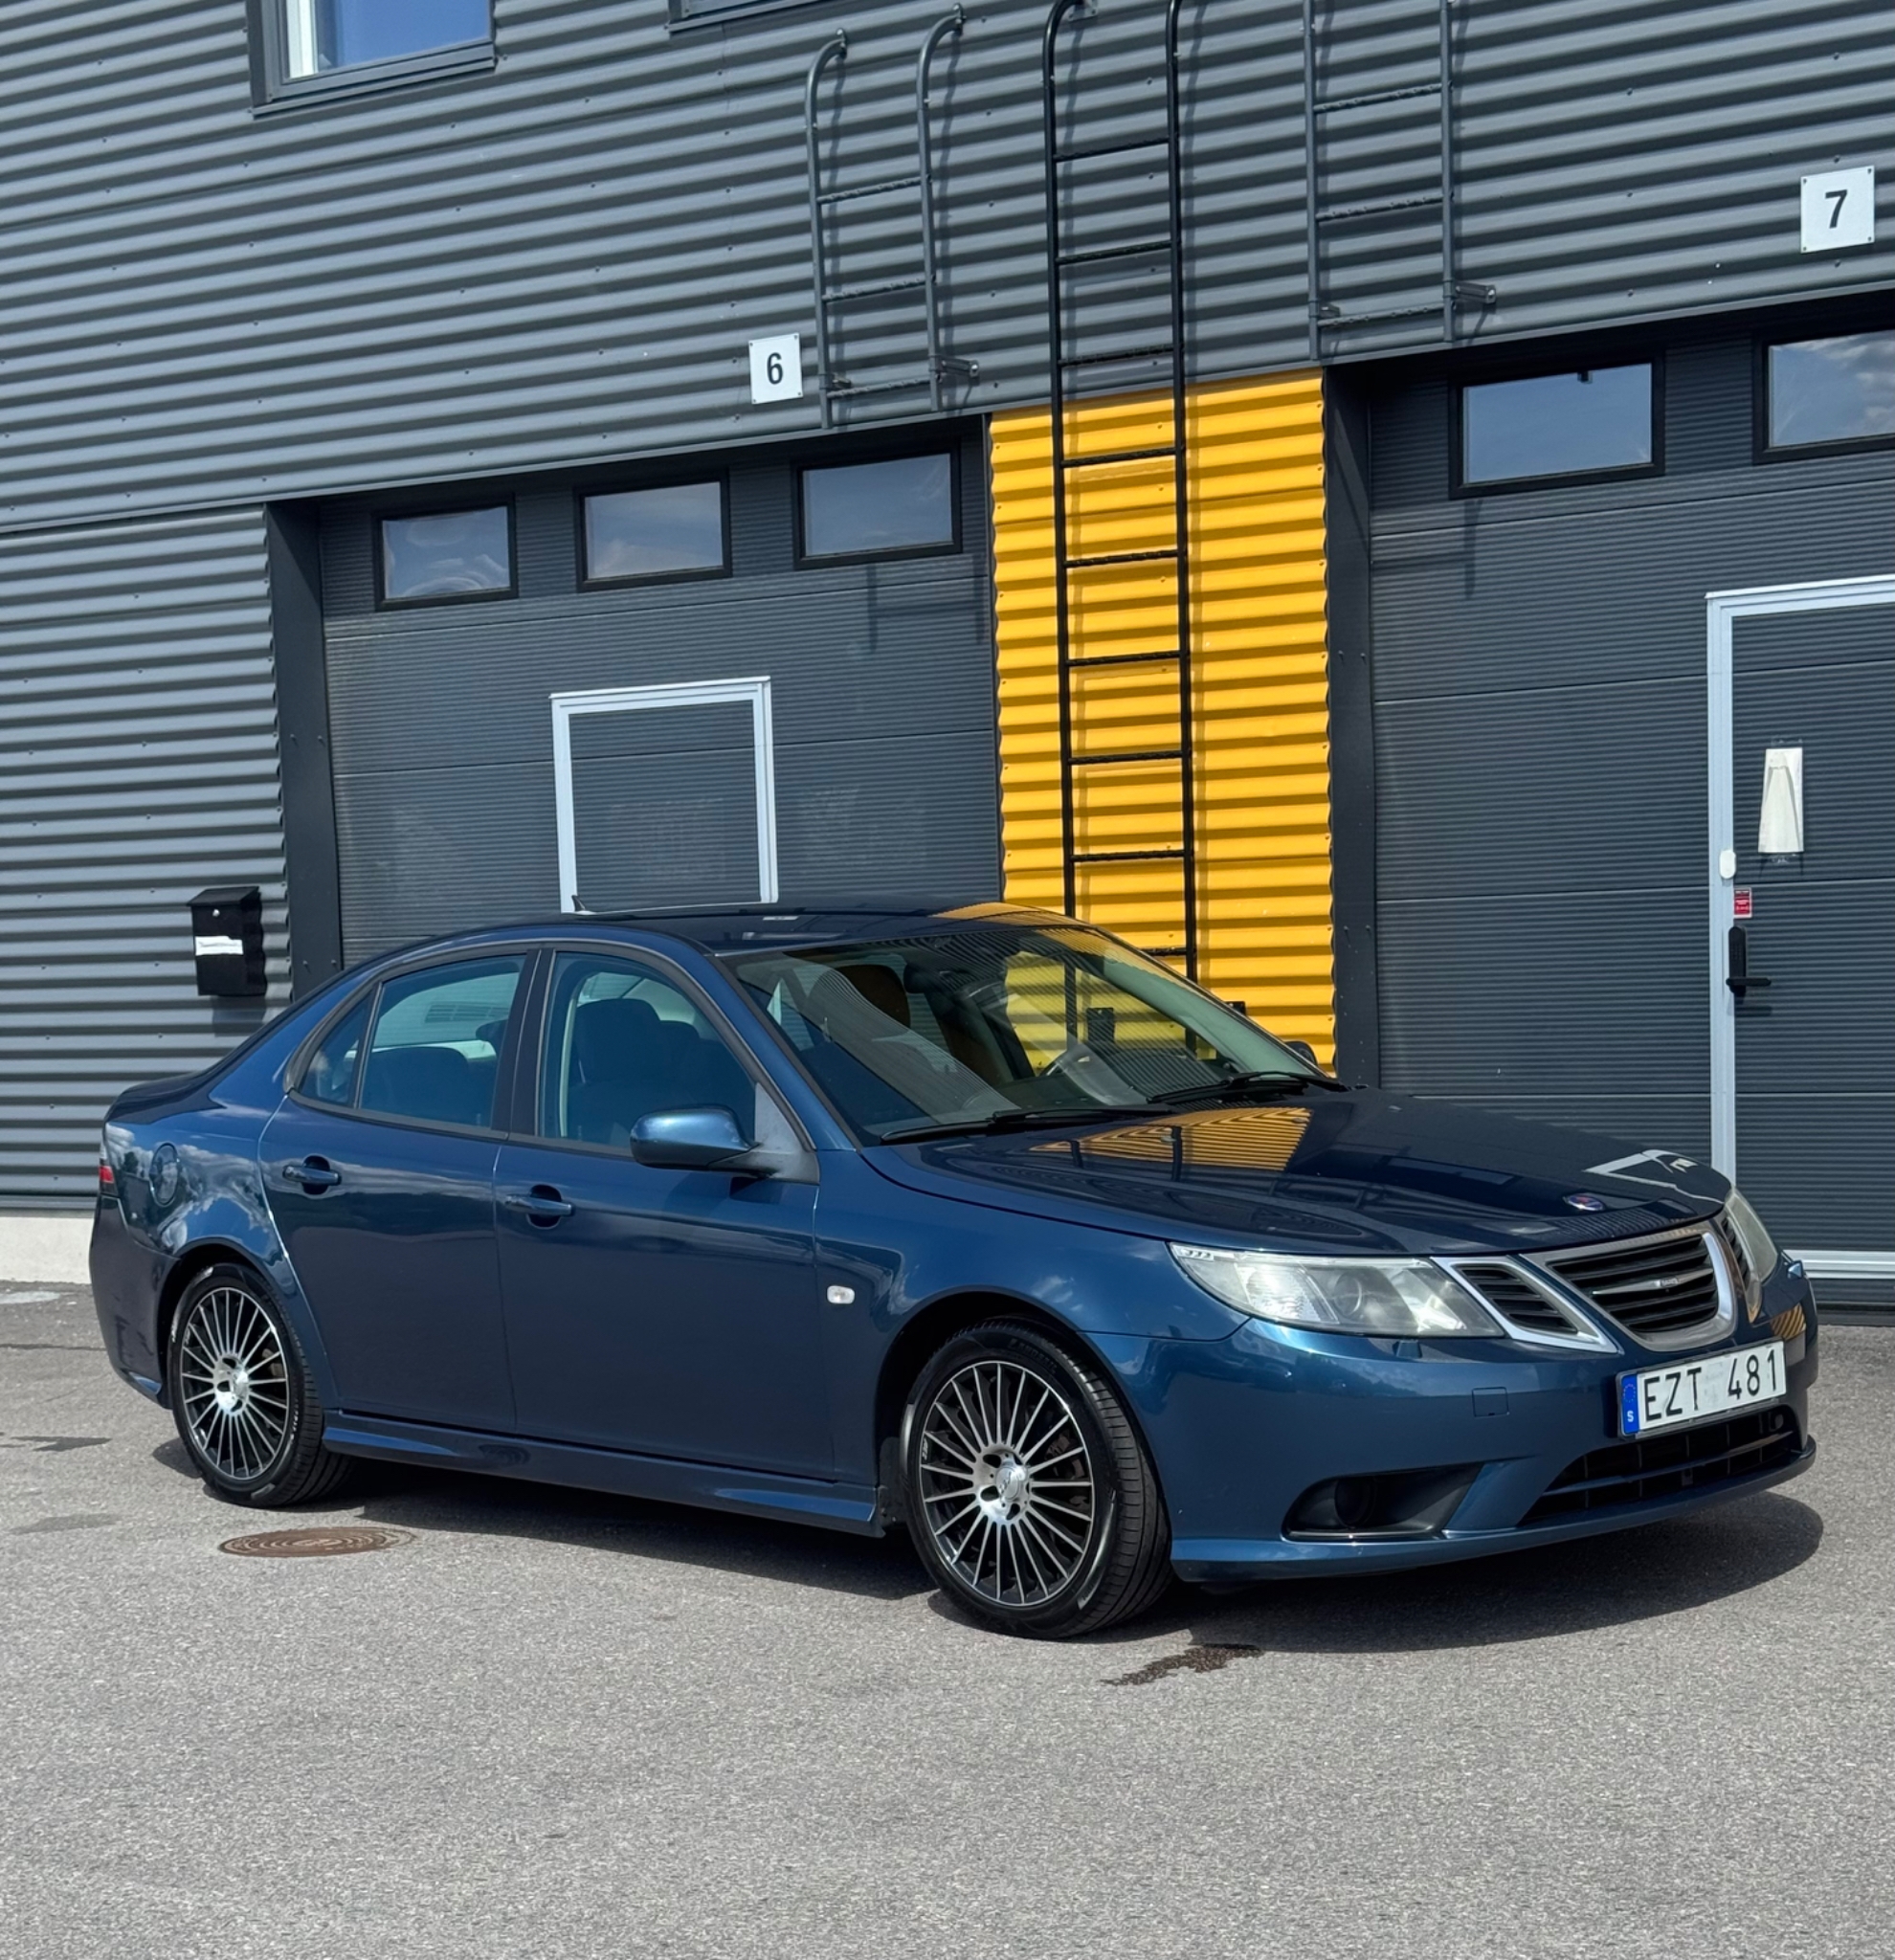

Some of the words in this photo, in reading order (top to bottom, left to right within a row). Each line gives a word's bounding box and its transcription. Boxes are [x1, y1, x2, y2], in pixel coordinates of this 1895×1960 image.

[1824, 189, 1848, 230] 7
[767, 351, 784, 386] 6
[1643, 1367, 1703, 1422] EZT
[1728, 1348, 1777, 1400] 481
[1627, 1410, 1635, 1423] S
